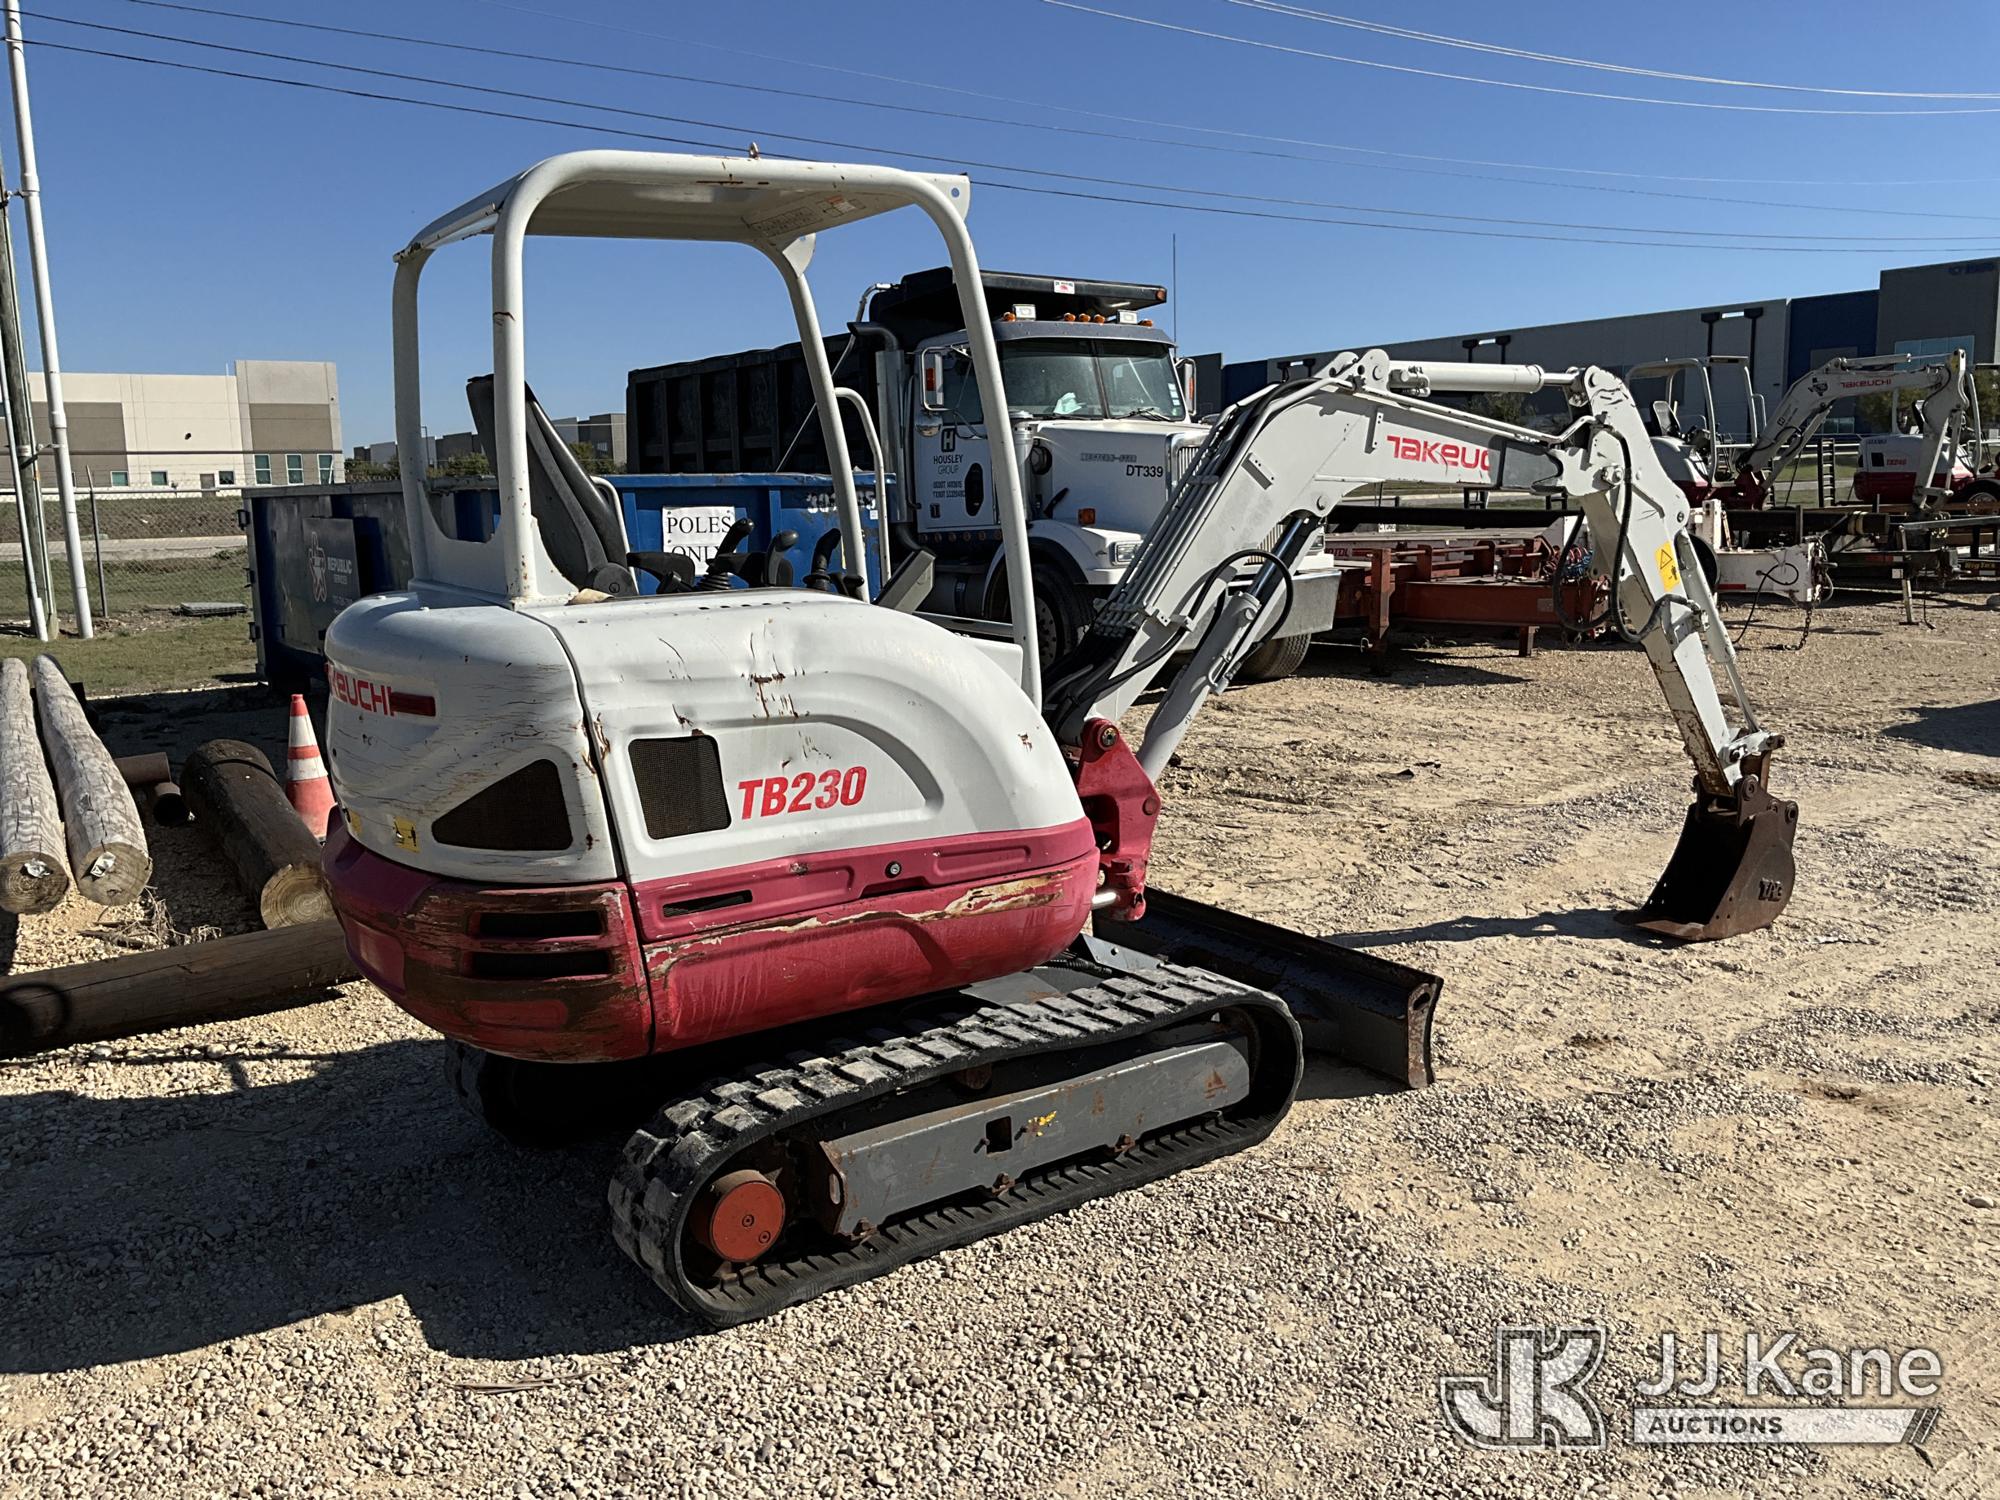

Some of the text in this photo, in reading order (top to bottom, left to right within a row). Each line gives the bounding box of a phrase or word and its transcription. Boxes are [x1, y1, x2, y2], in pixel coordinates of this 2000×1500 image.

[933, 454, 964, 465] HOUSLEY
[1125, 464, 1164, 478] DT339
[667, 516, 732, 534] POLES
[738, 766, 868, 820] TB230
